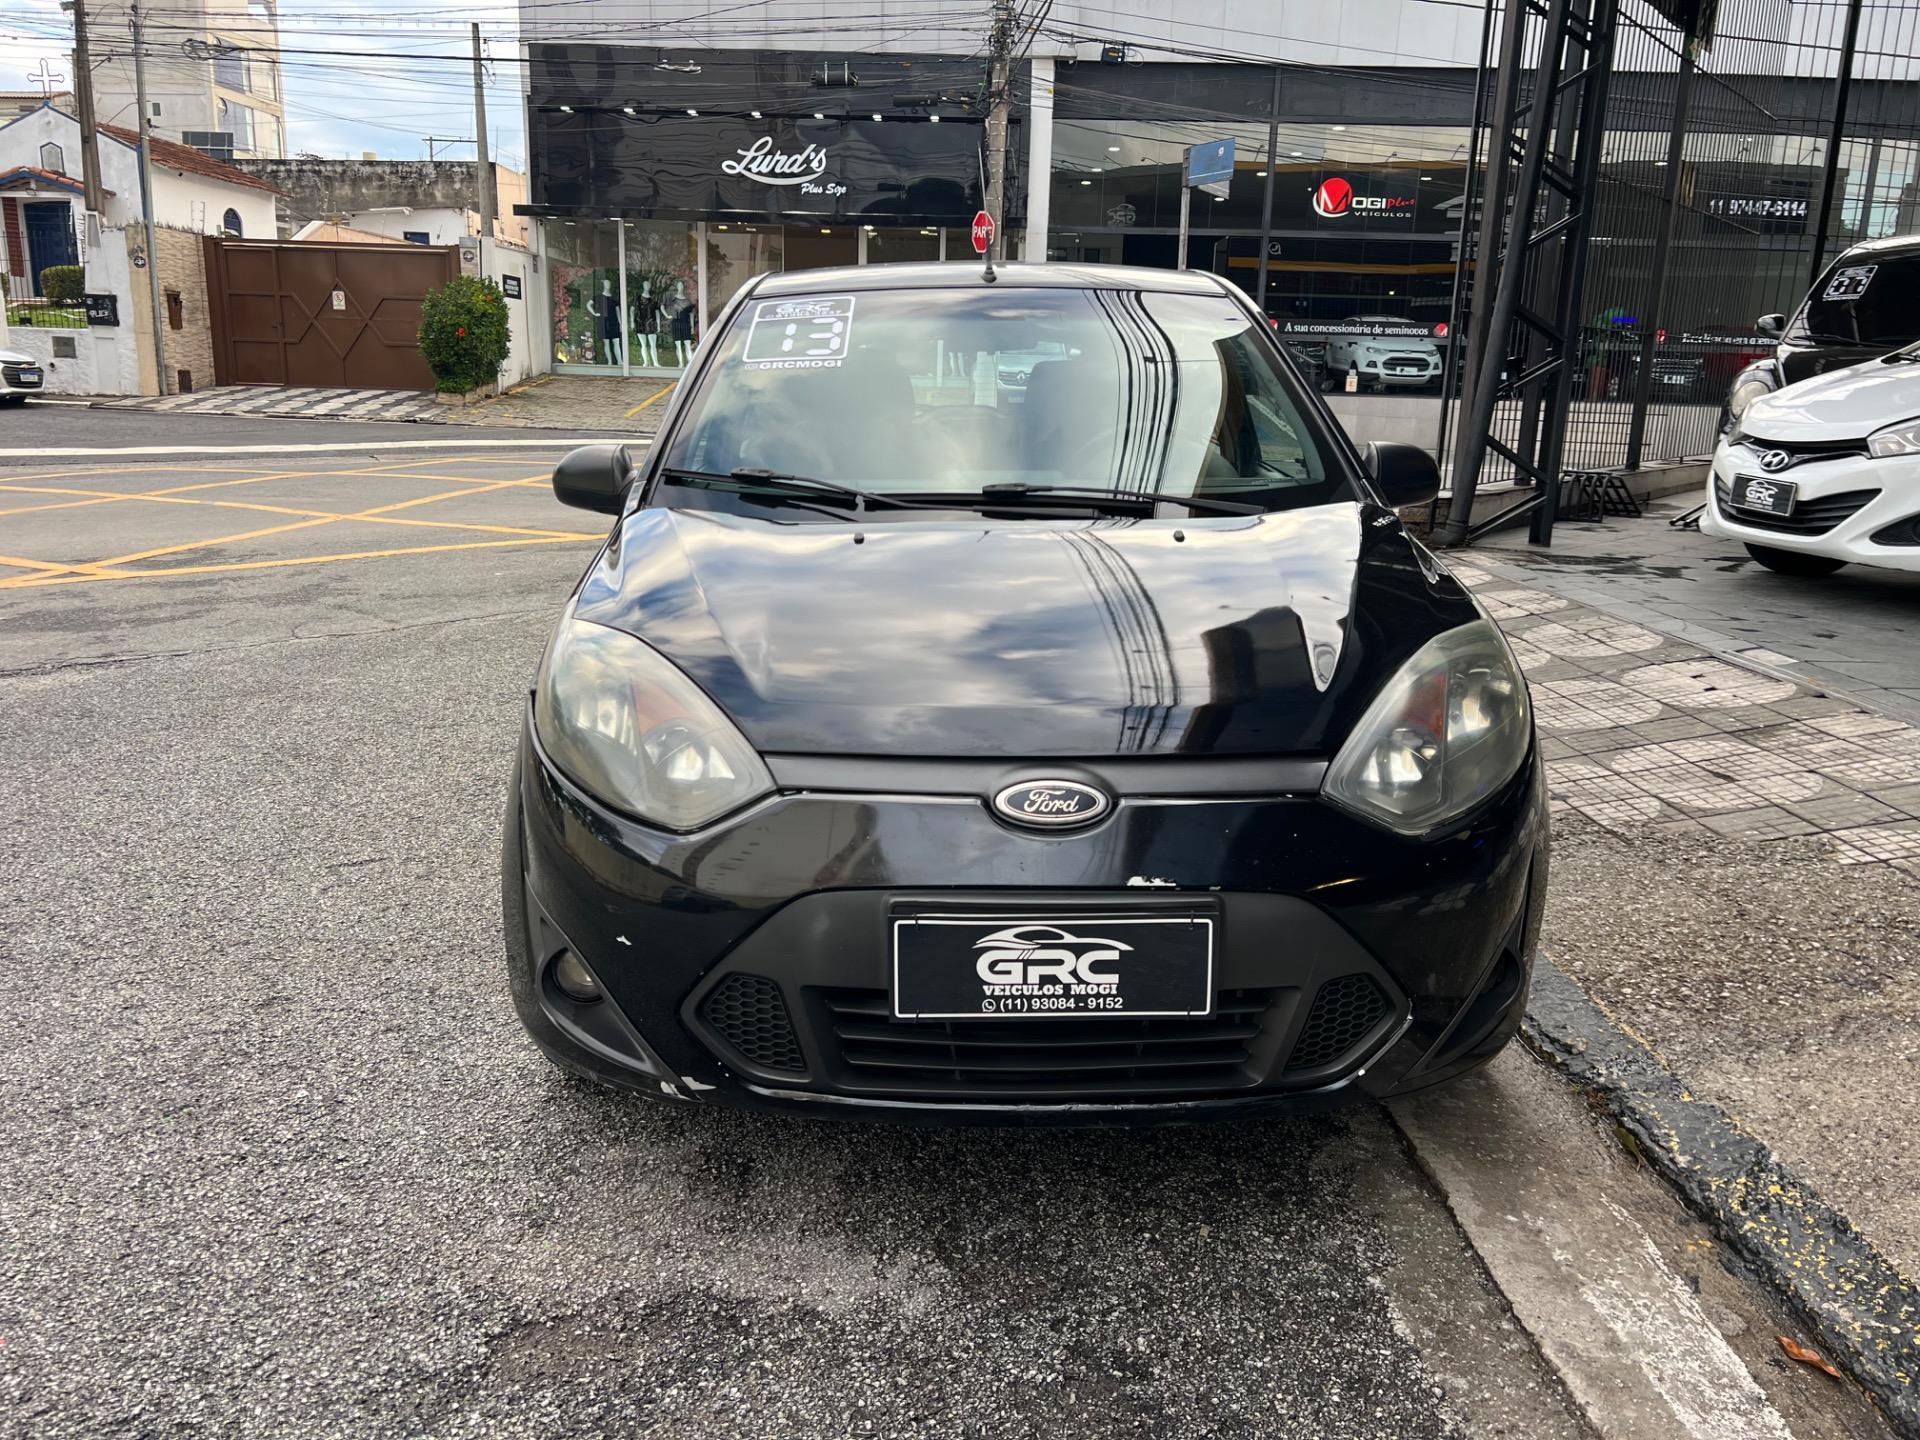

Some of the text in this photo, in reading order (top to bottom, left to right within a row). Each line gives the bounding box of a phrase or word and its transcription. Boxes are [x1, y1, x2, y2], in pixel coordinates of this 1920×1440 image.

[721, 136, 827, 175] Lurd's
[801, 182, 847, 196] Plus Size
[1829, 276, 1868, 296] 07
[782, 317, 844, 356] 13
[1284, 321, 1429, 336] A sua concessionária de seminovos
[760, 360, 842, 370] GRCMOGI
[1745, 486, 1776, 502] GRC
[1024, 789, 1080, 812] Ford
[976, 949, 1120, 984] GRC
[983, 984, 1118, 995] VEICULOS MOGI
[1000, 998, 1028, 1012] (11)
[1031, 998, 1076, 1010] 93084
[1088, 997, 1123, 1009] 9152
